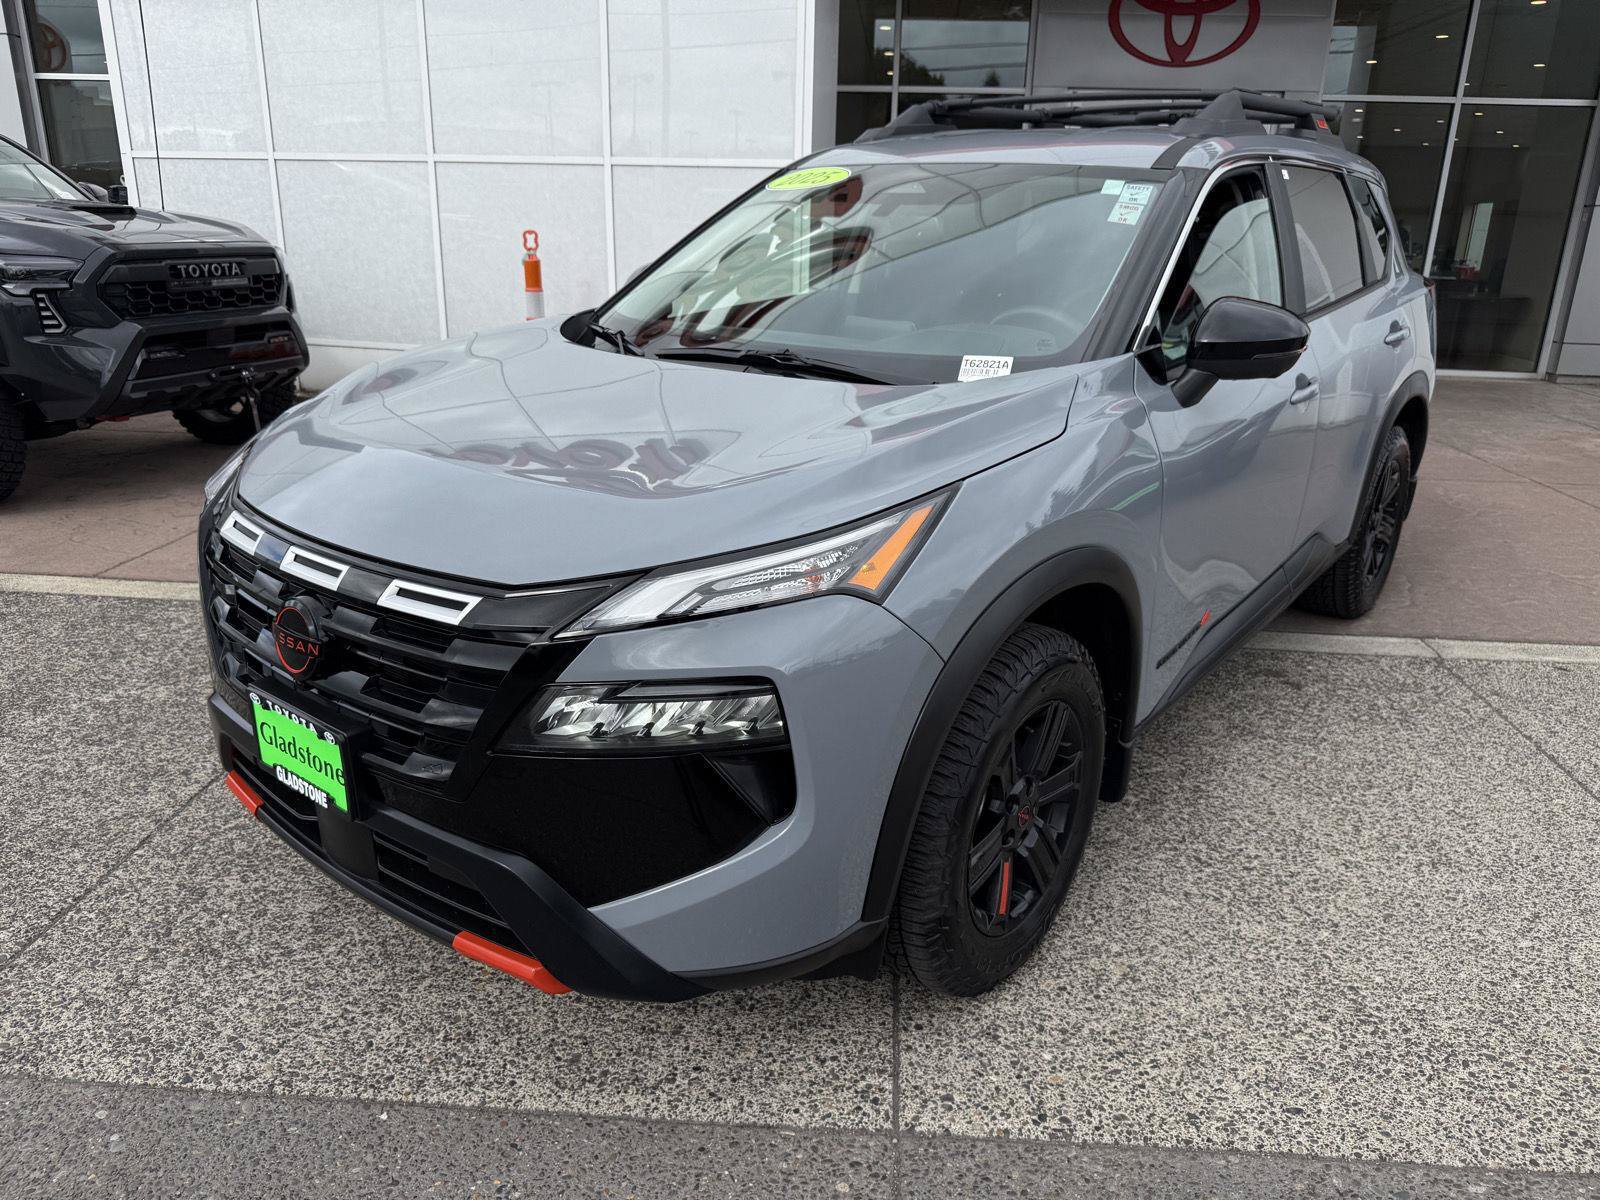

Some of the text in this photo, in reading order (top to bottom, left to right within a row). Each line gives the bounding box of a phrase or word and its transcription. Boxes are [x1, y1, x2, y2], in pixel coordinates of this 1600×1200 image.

[775, 171, 841, 187] 2025
[177, 262, 241, 278] TOYOTA
[964, 359, 1009, 369] T62821A
[278, 631, 319, 656] SSAN
[266, 700, 318, 736] TOYOTA
[259, 721, 346, 787] Gladstone
[275, 765, 329, 809] GLADSTONE
